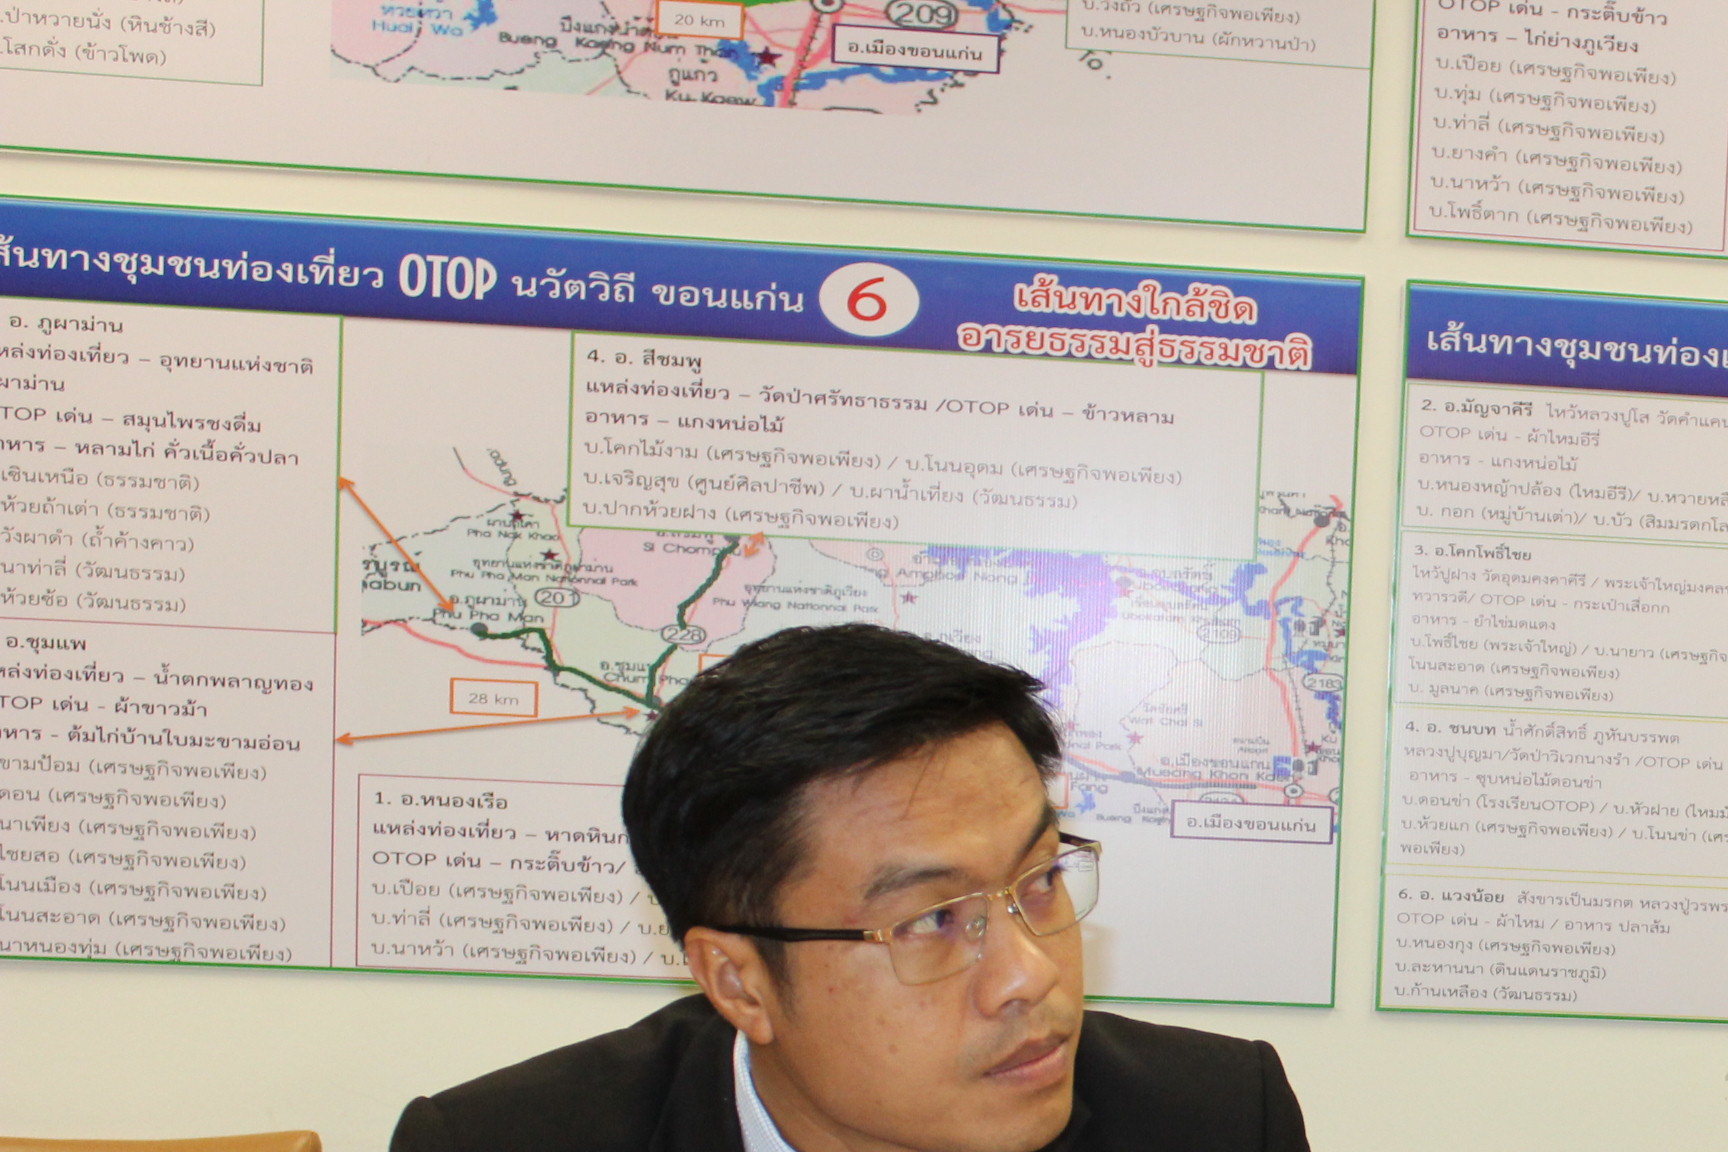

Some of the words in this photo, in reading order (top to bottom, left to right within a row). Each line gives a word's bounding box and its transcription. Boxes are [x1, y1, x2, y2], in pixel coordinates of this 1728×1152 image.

[674, 14, 694, 26] 20
[700, 16, 725, 28] km
[893, 2, 953, 24] 209
[120, 15, 216, 38] (หินช้างสี)
[848, 39, 982, 61] อ.เมืองขอนแก่น
[1081, 26, 1204, 44] บ.หนองบัวบาน
[1212, 32, 1316, 53] (ผักหวานป่า)
[1438, 27, 1497, 43] อาหาร
[1524, 27, 1638, 56] ไก่ย่างภูเวียง
[75, 42, 166, 66] (ข้าวโพด)
[1435, 53, 1501, 73] บ.เปือย
[1509, 60, 1676, 87] (เศรษฐกิจพอเพียง)
[1434, 84, 1481, 106] บ.ทุ่ม
[1489, 88, 1656, 115] (เศรษฐกิจพอเพียง)
[1433, 111, 1490, 131] บ.ท่าลี่
[1498, 118, 1665, 145] (เศรษฐกิจพอเพียง)
[1430, 174, 1510, 192] บ.นาหว้า
[1518, 179, 1685, 206] (เศรษฐกิจพอเพียง)
[1429, 199, 1519, 222] บ.โพธิ์ตาก
[1527, 210, 1693, 236] (เศรษฐกิจพอเพียง)
[399, 253, 497, 300] OTOP
[511, 267, 635, 303] นวัตวิถี
[652, 282, 804, 313] ขอนแก่น
[847, 276, 888, 322] 6
[1015, 274, 1256, 322] เส้นทางใกล้ชิด
[9, 316, 28, 328] อ.
[37, 315, 123, 335] ภูผาม่าน
[960, 324, 1311, 366] อารยธรรมสู่ธรรมชาติ
[160, 355, 313, 374] อุทยานแห่งชาติ
[587, 349, 605, 363] 4.
[615, 352, 633, 364] อ.
[643, 349, 701, 374] สีชมพู
[587, 378, 729, 400] แหล่งท่องเที่ยว
[759, 385, 927, 411] วัดป่าศรัทธาธรรม
[935, 399, 1010, 415] /OTOP
[1019, 401, 1053, 418] เด่น
[1082, 403, 1174, 425] ข้าวหลาม
[1421, 399, 1436, 411] 2.
[56, 407, 92, 424] เด่น
[123, 410, 261, 433] สมุนไพรชงดื่ม
[586, 411, 648, 425] อาหาร
[678, 415, 785, 433] แกงหน่อไม้
[75, 439, 155, 458] หลามไก่
[164, 438, 298, 466] คั่วเนื้อคั่วปลา
[584, 436, 698, 459] บ.โคกไม้งาม
[707, 445, 881, 470] (เศรษฐกิจพอเพียง)
[905, 453, 1003, 480] บ.โนนอุดม
[1011, 461, 1182, 486] (เศรษฐกิจพอเพียง)
[97, 471, 199, 492] (ธรรมชาติ)
[583, 469, 679, 493] บ.เจริญสุข
[688, 474, 825, 496] (ศูนย์ศิลปาชีพ)
[972, 488, 1078, 510] (วัฒนธรรม)
[107, 502, 210, 523] (ธรรมชาติ)
[582, 499, 716, 520] บ.ปากห้วยฝาง
[725, 506, 899, 530] (เศรษฐกิจพอเพียง)
[82, 525, 194, 553] (ถ้ำค้างคาว)
[1415, 545, 1428, 556] 3.
[75, 561, 185, 583] (วัฒนธรรม)
[77, 591, 186, 614] (วัฒนธรรม)
[540, 590, 575, 605] 201
[6, 636, 86, 654] อ.ชุมแพ
[668, 626, 703, 642] 228
[154, 663, 313, 695] น้ำตกพลาญทอง
[53, 695, 88, 712] เด่น
[115, 696, 207, 717] ผ้าขาวม้า
[468, 693, 488, 704] 28
[495, 693, 519, 705] km
[68, 724, 300, 751] ต้มไก่บ้านใบมะขามอ่อน
[1405, 721, 1419, 732] 4.
[1427, 723, 1441, 733] อ.
[1449, 724, 1496, 735] ชนบท
[89, 759, 267, 781] (เศรษฐกิจพอเพียง)
[48, 788, 226, 810] (เศรษฐกิจพอเพียง)
[376, 792, 391, 805] 1.
[401, 792, 508, 809] อ.หนองเรือ
[79, 819, 256, 841] (เศรษฐกิจพอเพียง)
[373, 818, 516, 840] แหล่งท่องเที่ยว
[1187, 817, 1316, 833] อ.เมืองขอนแก่น
[372, 851, 437, 866] OTOP
[446, 852, 481, 868] เด่น
[372, 878, 440, 897] บ.เปือย
[449, 883, 623, 905] (เศรษฐกิจพอเพียง)
[1398, 888, 1412, 900] 6.
[1420, 891, 1434, 900] อ.
[1442, 888, 1504, 903] แวงน้อย
[371, 905, 430, 926] บ.ท่าลี่
[439, 913, 613, 935] (เศรษฐกิจพอเพียง)
[371, 939, 454, 957] บ.นาหว้า
[463, 943, 636, 965] (เศรษฐกิจพอเพียง)
